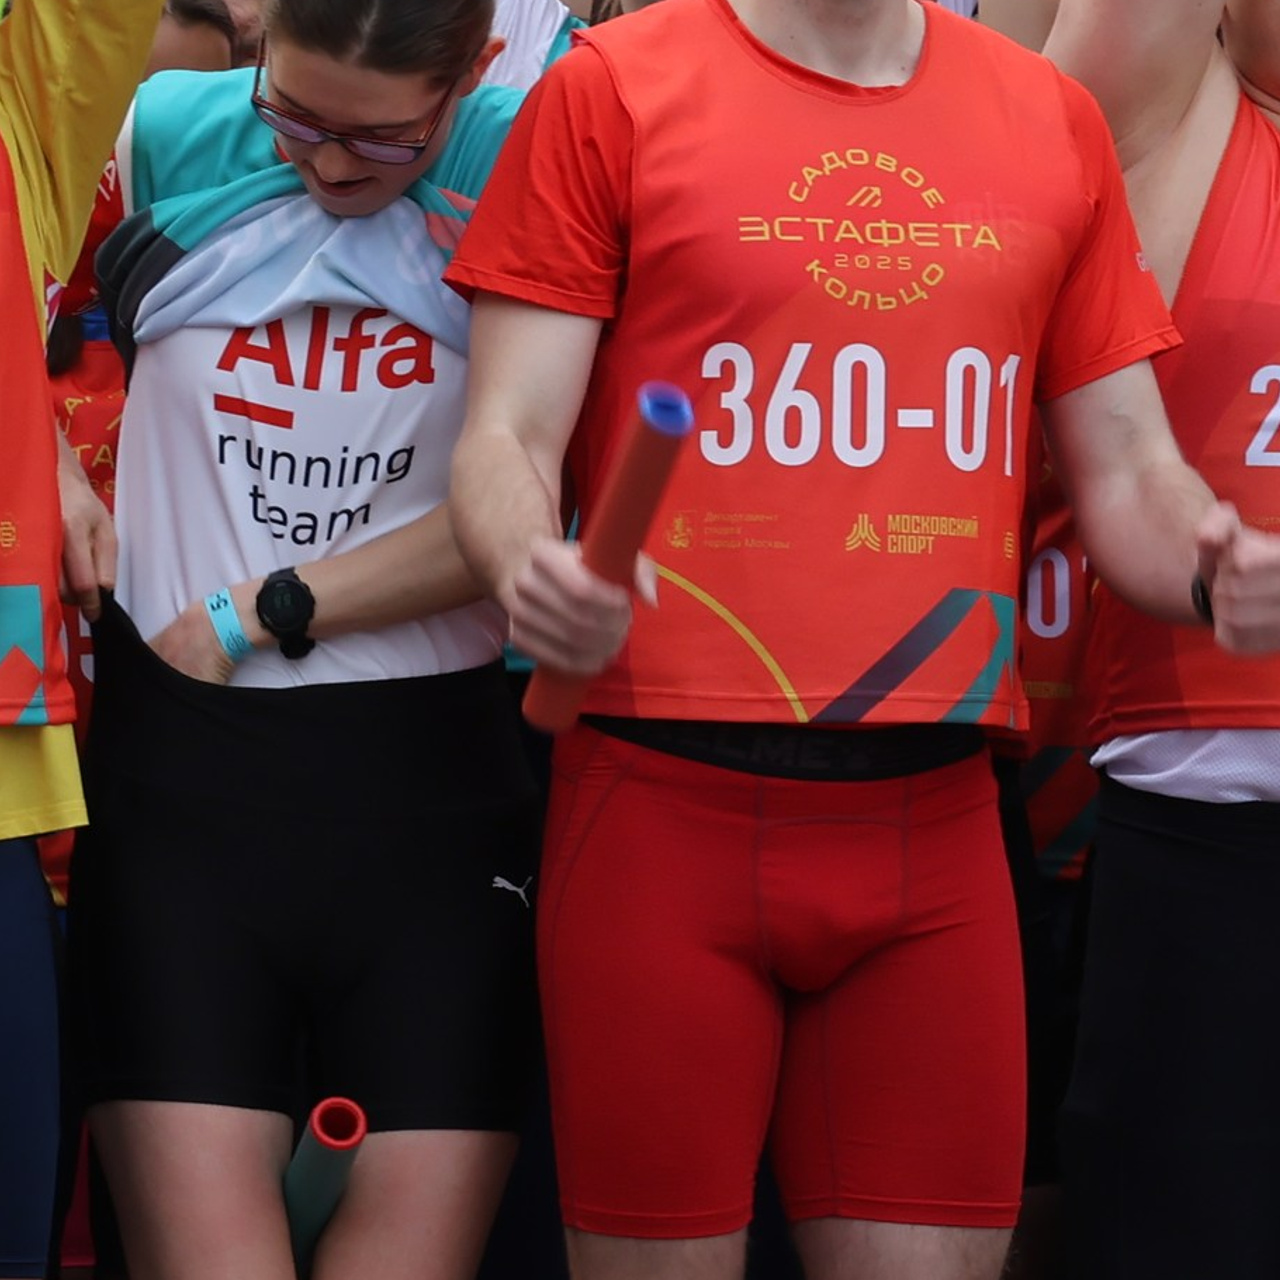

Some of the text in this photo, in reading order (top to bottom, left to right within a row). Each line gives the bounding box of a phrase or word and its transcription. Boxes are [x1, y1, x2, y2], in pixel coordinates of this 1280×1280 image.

[789, 148, 946, 209] САДОВОЕ
[737, 216, 1002, 251] ЭСТАФЕТА
[805, 258, 945, 312] КОЛЬЦО
[834, 253, 913, 271] 2025
[216, 305, 436, 394] Alfa
[699, 341, 1021, 477] 360-01
[218, 433, 416, 490] running
[250, 483, 372, 545] team
[887, 515, 979, 539] МОСКОВСКИЙ
[887, 534, 936, 554] СПОРТ
